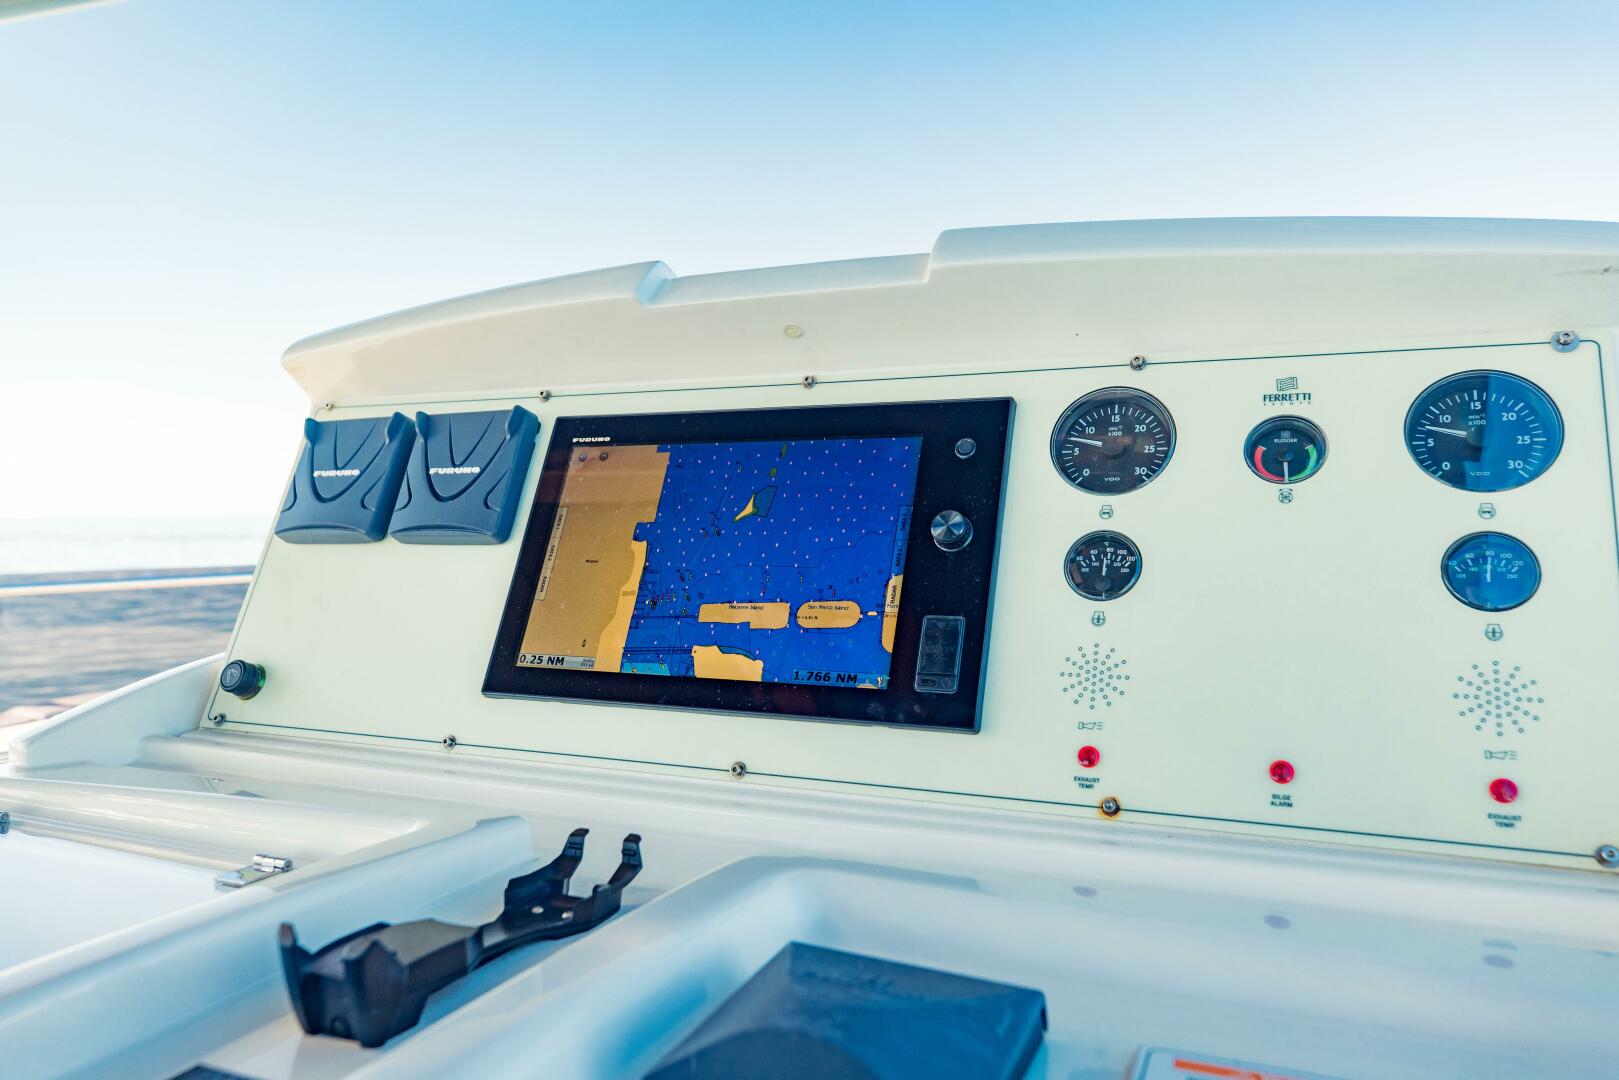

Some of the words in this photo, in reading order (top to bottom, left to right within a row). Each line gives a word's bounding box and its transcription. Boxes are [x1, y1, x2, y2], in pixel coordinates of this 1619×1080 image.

[1263, 392, 1312, 402] FERRETTI
[1470, 402, 1482, 410] 15
[1111, 415, 1121, 423] 15
[1439, 415, 1452, 423] 10
[1501, 412, 1517, 421] 20
[1085, 426, 1095, 435] 10
[1134, 424, 1147, 433] 20
[1427, 438, 1434, 447] 5
[1516, 436, 1531, 444] 25
[1144, 445, 1156, 453] 25
[1442, 461, 1451, 470] 0
[1507, 460, 1524, 469] 30
[313, 469, 360, 477] FURUNO
[429, 466, 480, 474] FURUNO
[1082, 468, 1090, 476] 0
[1134, 467, 1148, 475] 30
[519, 654, 544, 665] 0.25
[546, 656, 565, 666] NM
[793, 671, 831, 682] 1.766
[836, 673, 858, 684] NM
